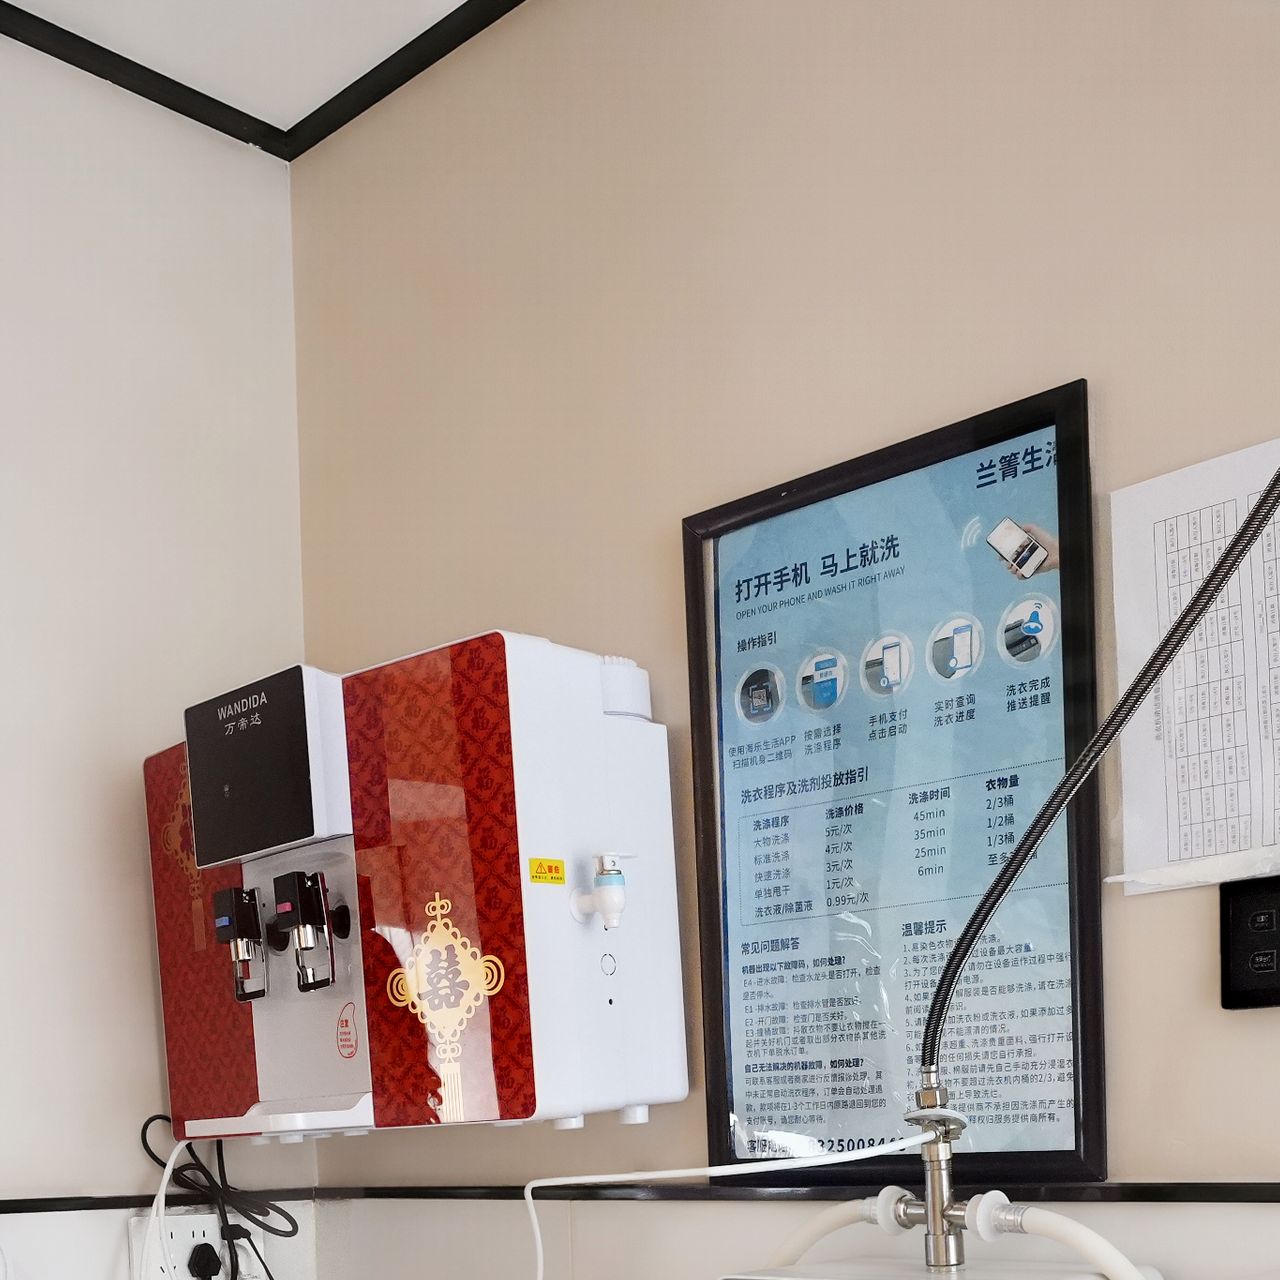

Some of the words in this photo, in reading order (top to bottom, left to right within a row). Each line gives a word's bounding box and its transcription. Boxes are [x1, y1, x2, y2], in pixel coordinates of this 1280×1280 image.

[735, 561, 810, 603] 打开手机
[820, 535, 900, 577] 马上就洗
[736, 606, 756, 620] OPEN
[757, 602, 778, 615] YOUR
[779, 596, 805, 610] PHONE
[807, 590, 823, 603] AND
[824, 583, 847, 597] WASH
[848, 580, 856, 592] IT
[858, 574, 881, 588] RIGHT
[883, 565, 906, 581] AWAY
[737, 631, 777, 653] 操作指引
[1005, 676, 1051, 697] 洗衣完成
[217, 691, 268, 721] WANDIDA
[933, 693, 976, 713] 实时查询
[1006, 691, 1052, 713] 推送提醒
[224, 712, 262, 736] 万帝达
[869, 708, 908, 727] 手机支付
[933, 708, 976, 728] 洗衣进度
[804, 723, 842, 742] 按需选择
[868, 723, 908, 742] 点击启动
[728, 735, 797, 757] 使用海乐生活APP
[804, 738, 842, 756] 洗涤程序
[732, 749, 793, 770] 扫描机身二维码
[740, 766, 869, 805] 洗衣程序及洗剂投放指引
[985, 774, 1020, 792] 衣物量
[908, 786, 951, 805] 洗涤时间
[986, 794, 1014, 810] 2/3桶
[825, 802, 865, 820] 洗涤价格
[913, 809, 946, 822] 45min
[752, 815, 790, 832] 洗涤程序
[987, 812, 1015, 829] 1/2桶
[825, 823, 853, 838] 5元/次
[914, 828, 946, 841] 35min
[987, 832, 1015, 847] 1/3桶
[753, 832, 790, 850] 大物洗涤
[825, 840, 853, 855] 4元/次
[753, 850, 790, 867] 标准洗涤
[914, 846, 947, 859] 25min
[826, 858, 853, 873] 3元/次
[917, 864, 944, 877] 6min
[754, 868, 791, 884] 快速洗涤
[826, 876, 854, 891] 1元/次
[754, 885, 791, 900] 单独甩干
[826, 891, 870, 908] 0.99元/次
[754, 900, 814, 919] 洗衣液/除菌液
[901, 919, 947, 937] 温馨提示
[741, 937, 800, 956] 常见问题解答
